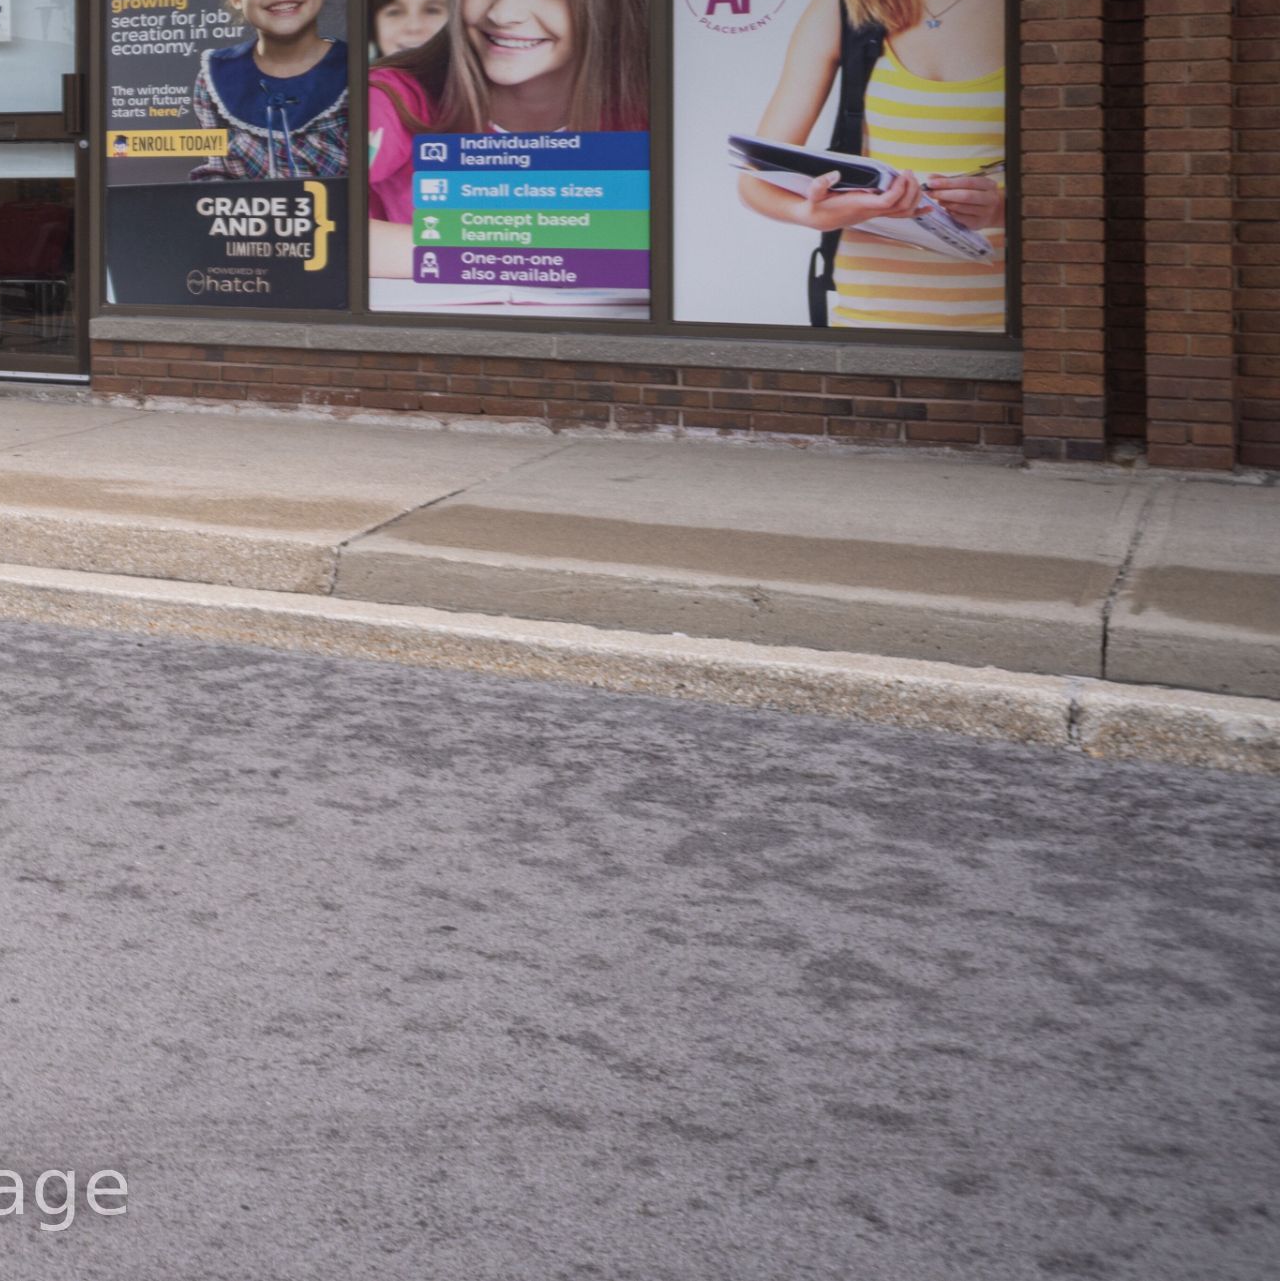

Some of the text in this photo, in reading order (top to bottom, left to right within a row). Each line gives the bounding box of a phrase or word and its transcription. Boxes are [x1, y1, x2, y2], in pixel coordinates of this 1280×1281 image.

[111, 9, 231, 28] sector for job
[699, 14, 772, 34] PLACEMENT
[111, 25, 245, 43] creation in our
[111, 42, 198, 56] economy.
[112, 84, 188, 96] The window
[112, 95, 191, 106] to our future
[112, 108, 146, 118] starts
[132, 136, 223, 151] ENROLL TODAY!
[460, 135, 581, 150] Individualised
[460, 152, 531, 168] learning
[460, 183, 603, 198] Small class sizes
[196, 197, 311, 216] GRADE 3
[208, 218, 312, 237] AND UP
[460, 213, 590, 229] Concept based
[461, 228, 532, 244] learning
[226, 241, 312, 258] LIMITED SPACE
[461, 251, 564, 266] One-on-one
[461, 268, 577, 283] also available
[206, 276, 271, 293] hatch
